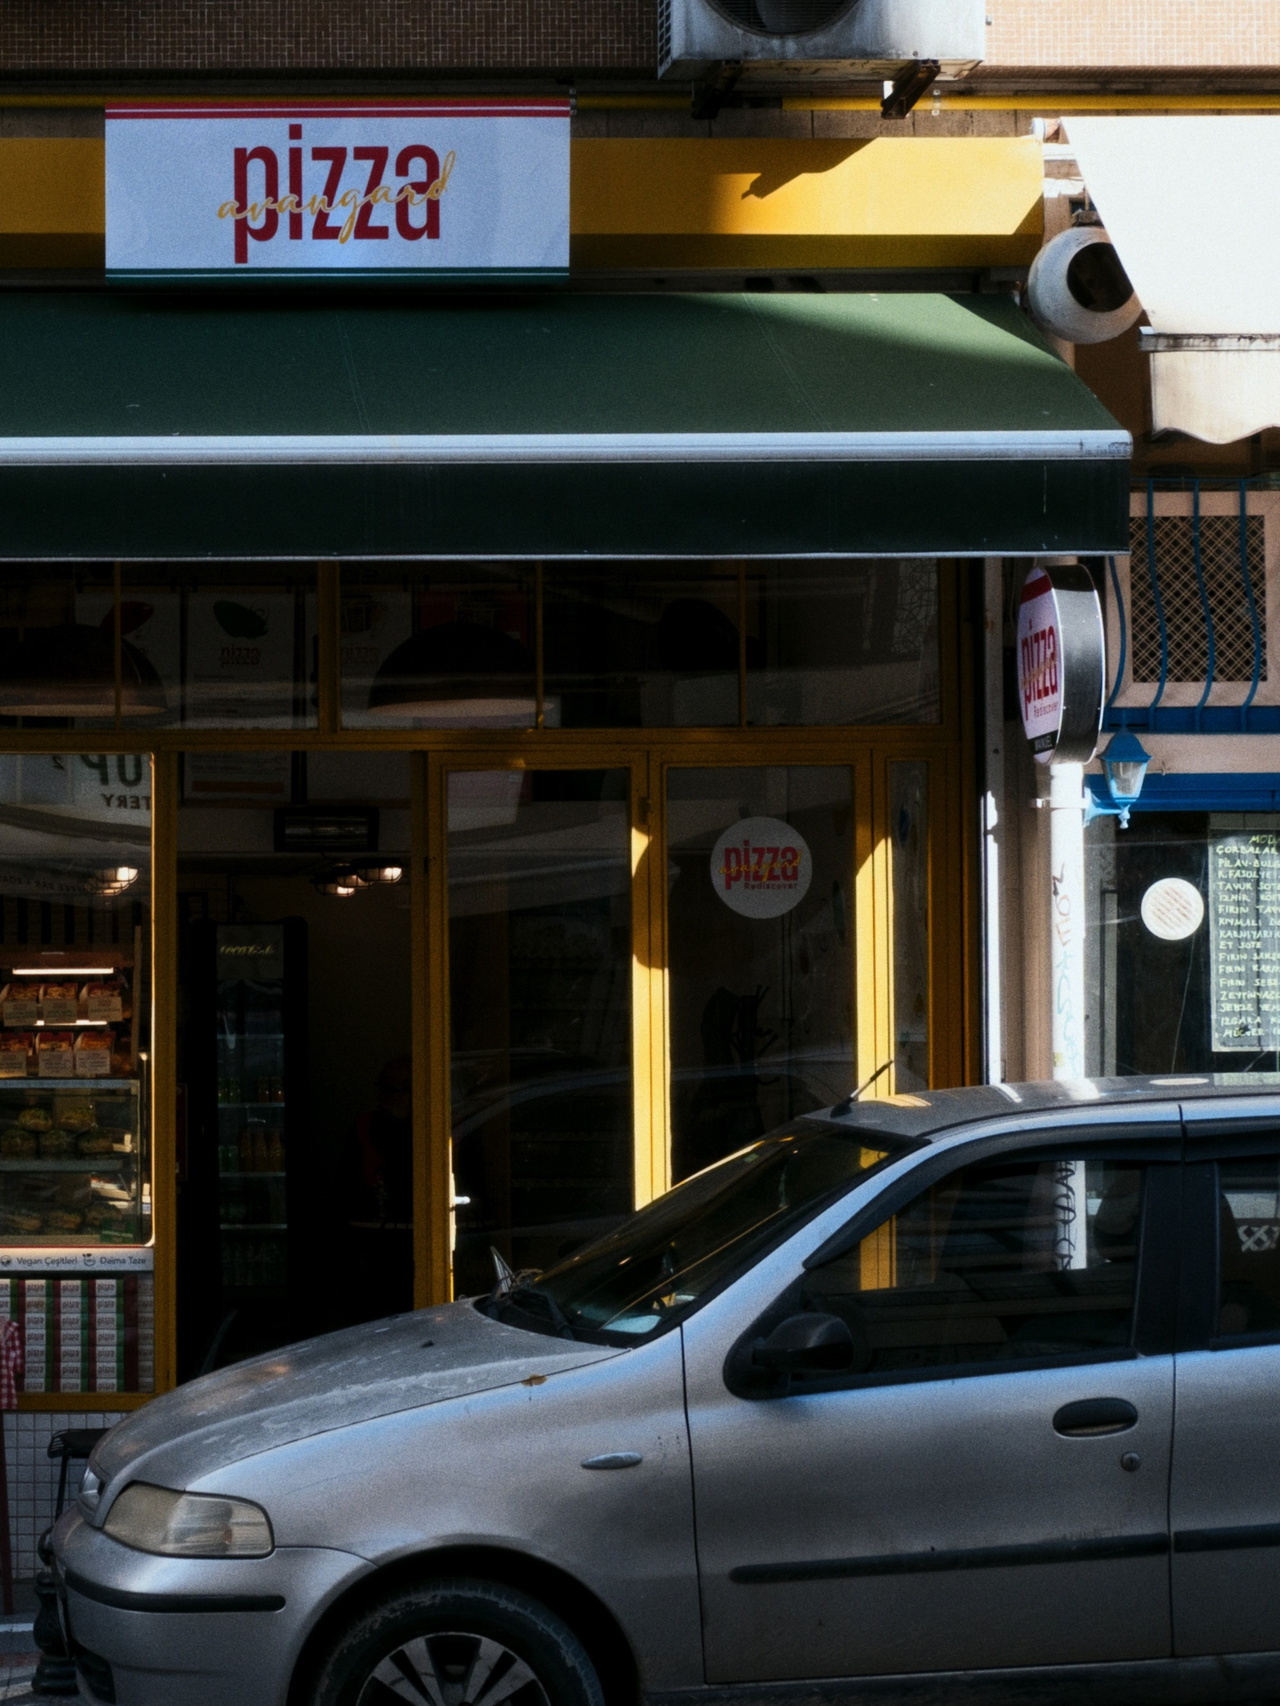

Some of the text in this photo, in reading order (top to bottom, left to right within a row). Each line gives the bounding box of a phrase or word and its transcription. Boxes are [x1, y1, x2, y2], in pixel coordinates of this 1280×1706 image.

[217, 151, 456, 245] avangard
[234, 124, 440, 263] pizza
[1021, 619, 1058, 721] pizza
[724, 839, 799, 890] pizza
[16, 1257, 42, 1267] Vegan
